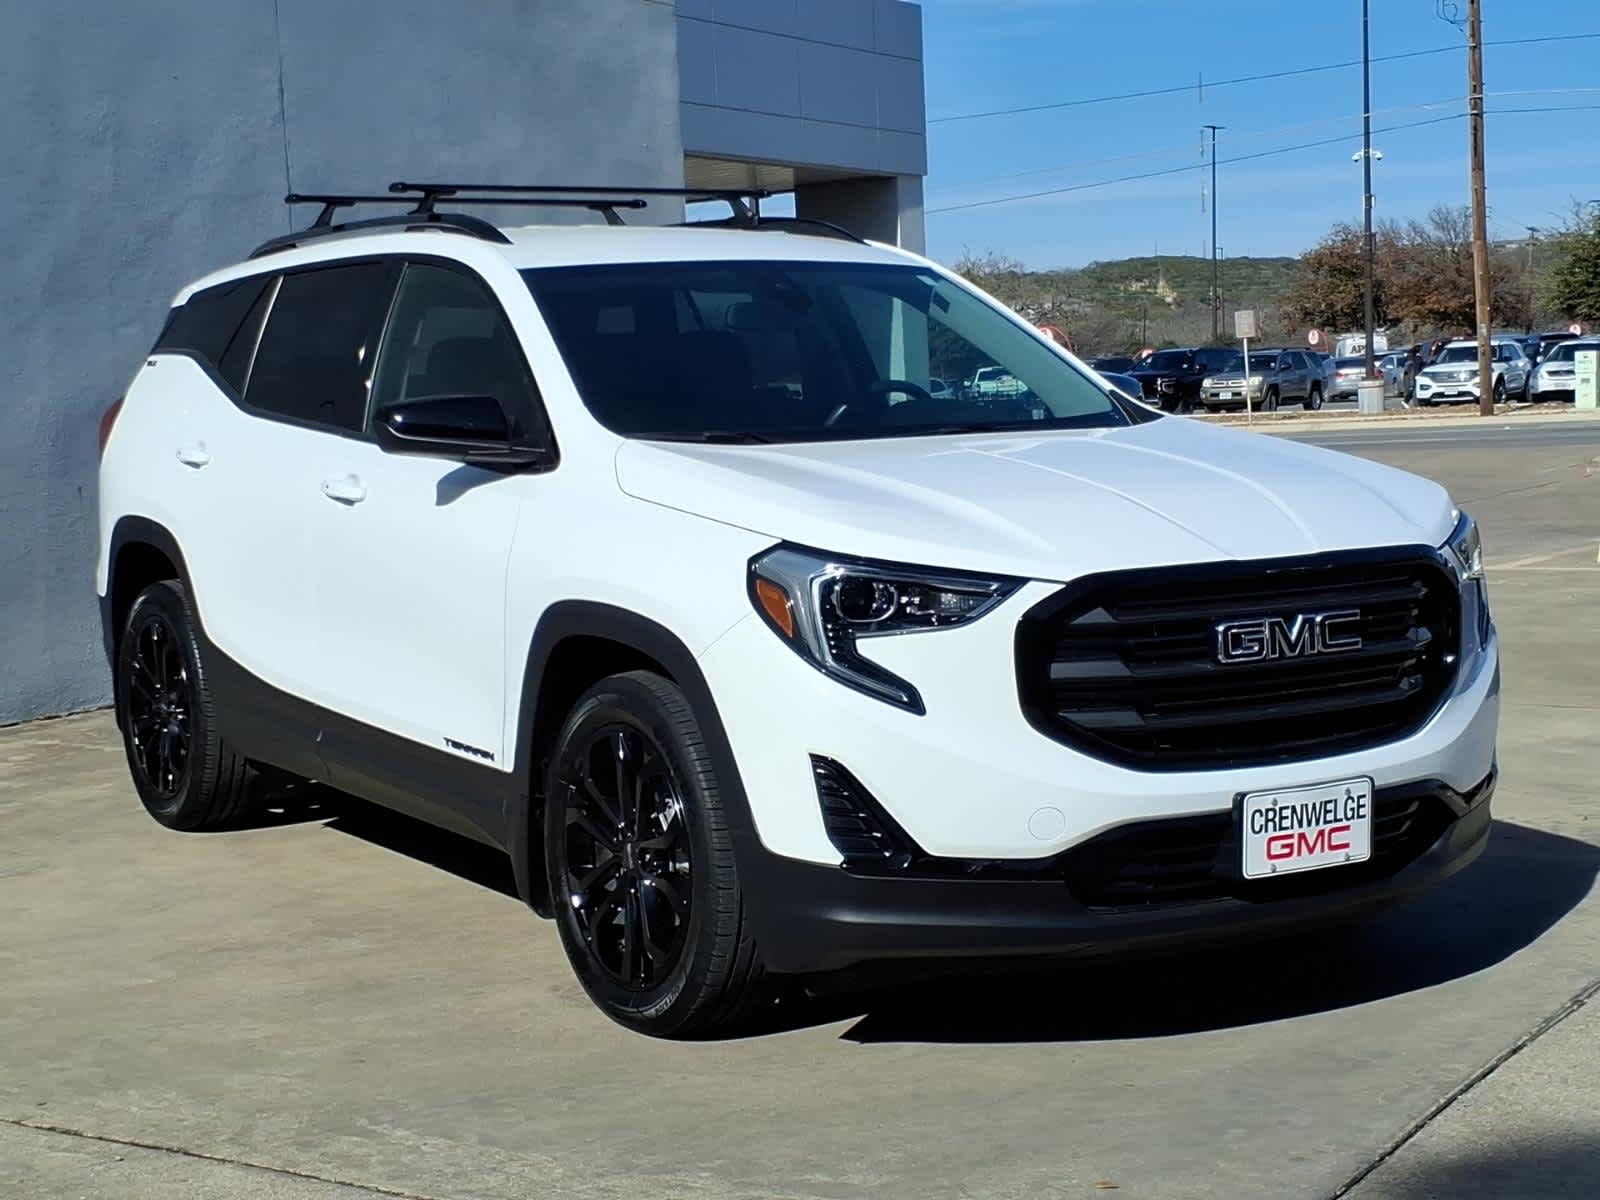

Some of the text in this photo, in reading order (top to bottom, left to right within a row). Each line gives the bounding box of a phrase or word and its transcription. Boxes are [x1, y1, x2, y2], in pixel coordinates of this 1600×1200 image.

[1215, 609, 1362, 664] GMC
[1250, 793, 1367, 835] CRENWELGE
[1265, 824, 1352, 861] GMC
